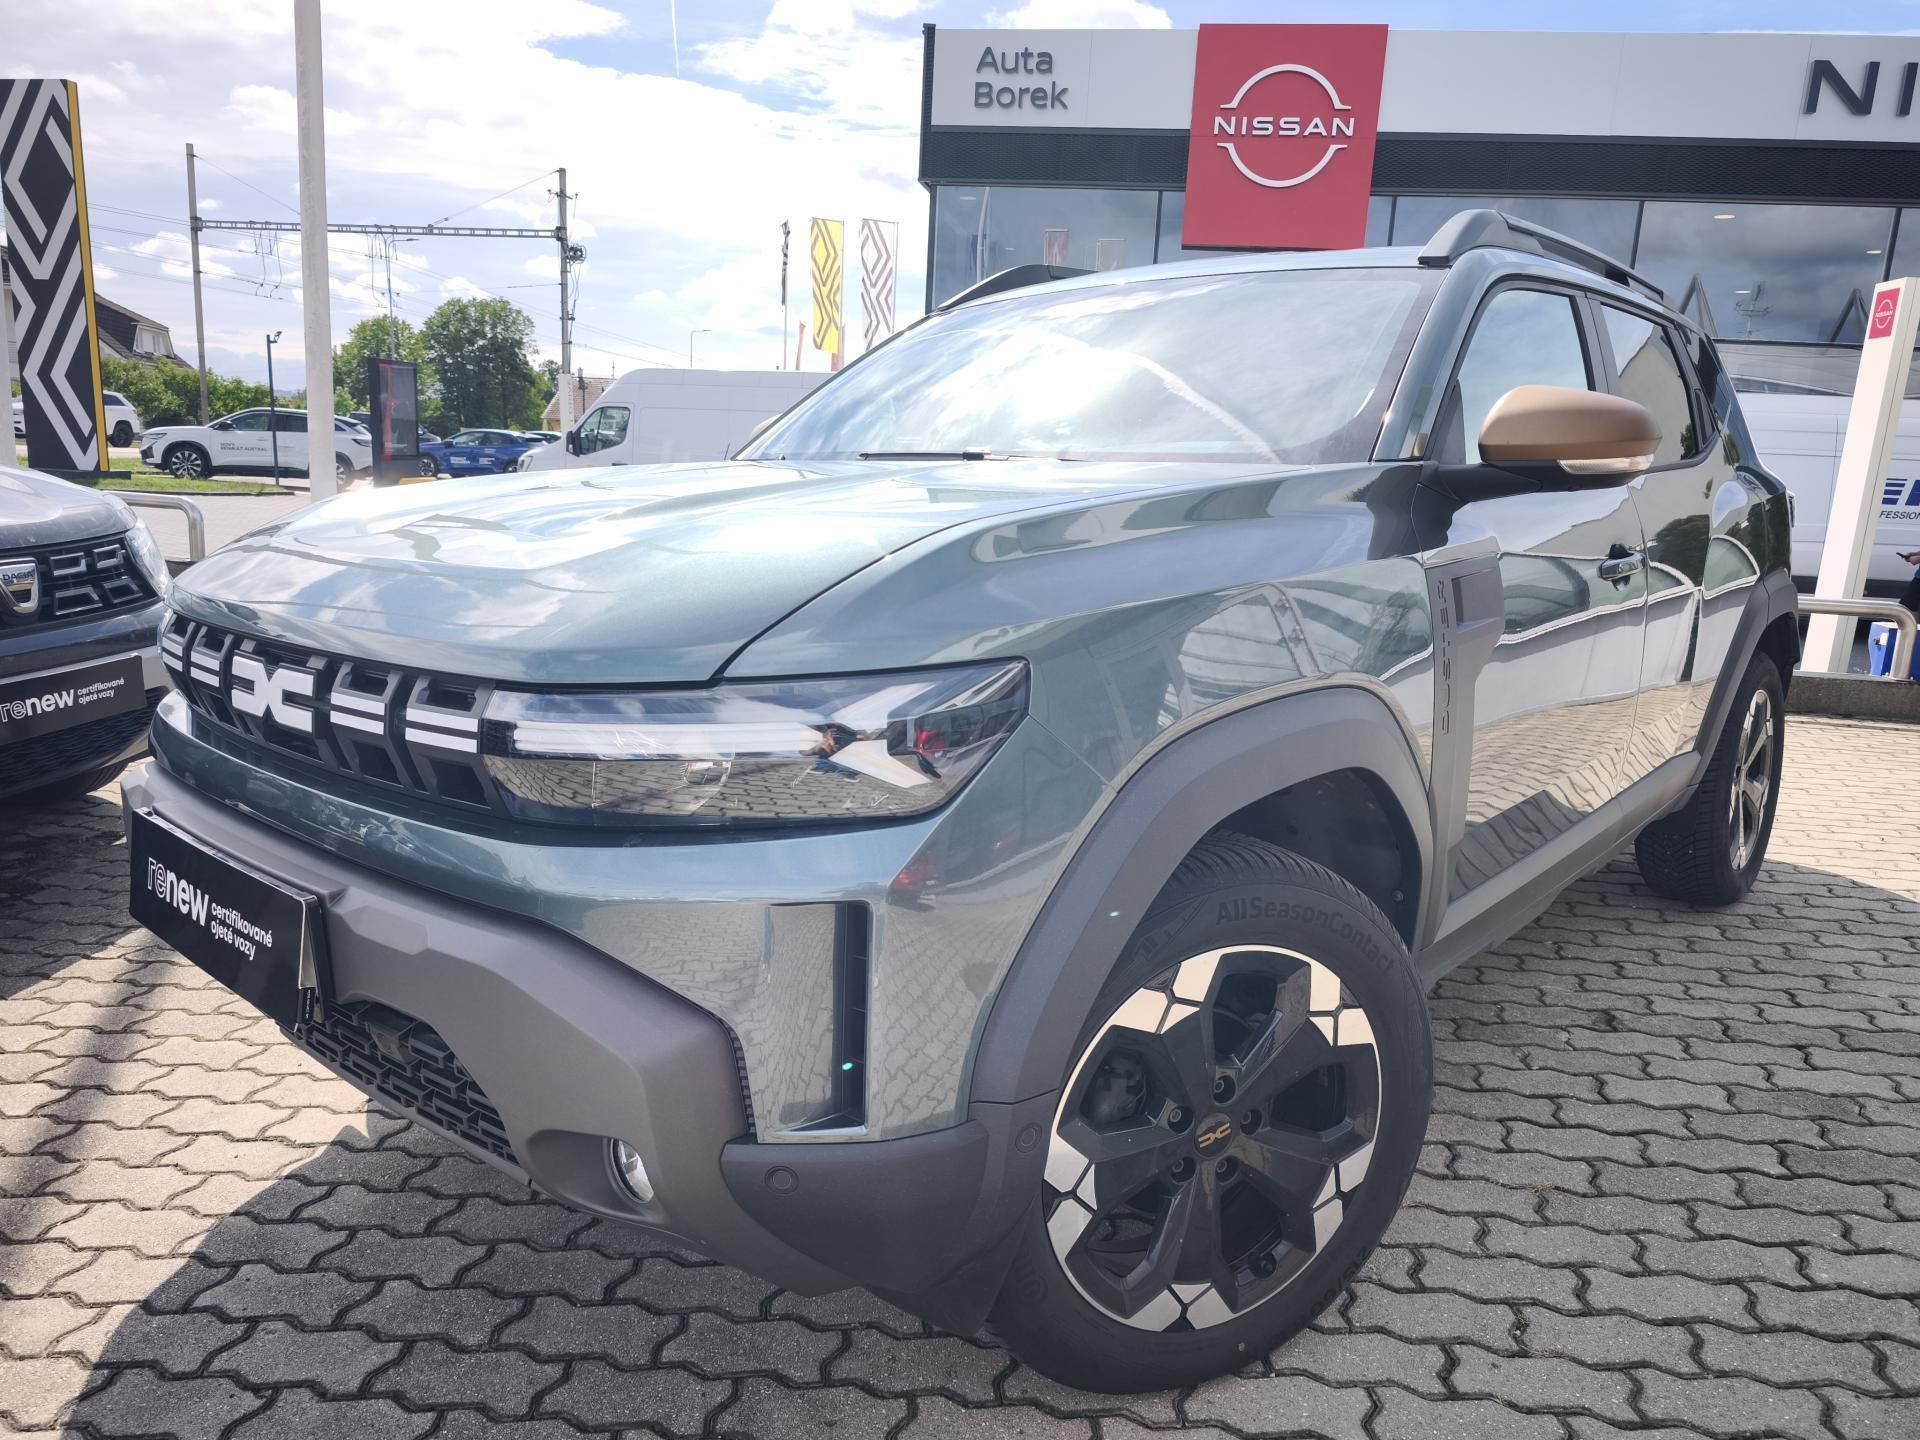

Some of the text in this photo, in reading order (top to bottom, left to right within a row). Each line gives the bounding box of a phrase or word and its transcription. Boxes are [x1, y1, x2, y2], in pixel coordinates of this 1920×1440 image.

[975, 46, 1054, 75] Auta
[974, 80, 1070, 110] Borek
[1804, 59, 1919, 118] NI
[1213, 116, 1356, 137] NISSAN
[2, 571, 34, 581] DACIA
[77, 676, 125, 696] certifikované
[78, 689, 115, 705] ojeté vozy
[0, 688, 75, 723] renew
[147, 857, 210, 927] renew
[211, 902, 273, 948] certifikované
[211, 920, 256, 961] ojeté vozy
[1215, 896, 1396, 972] AllSeasonContact
